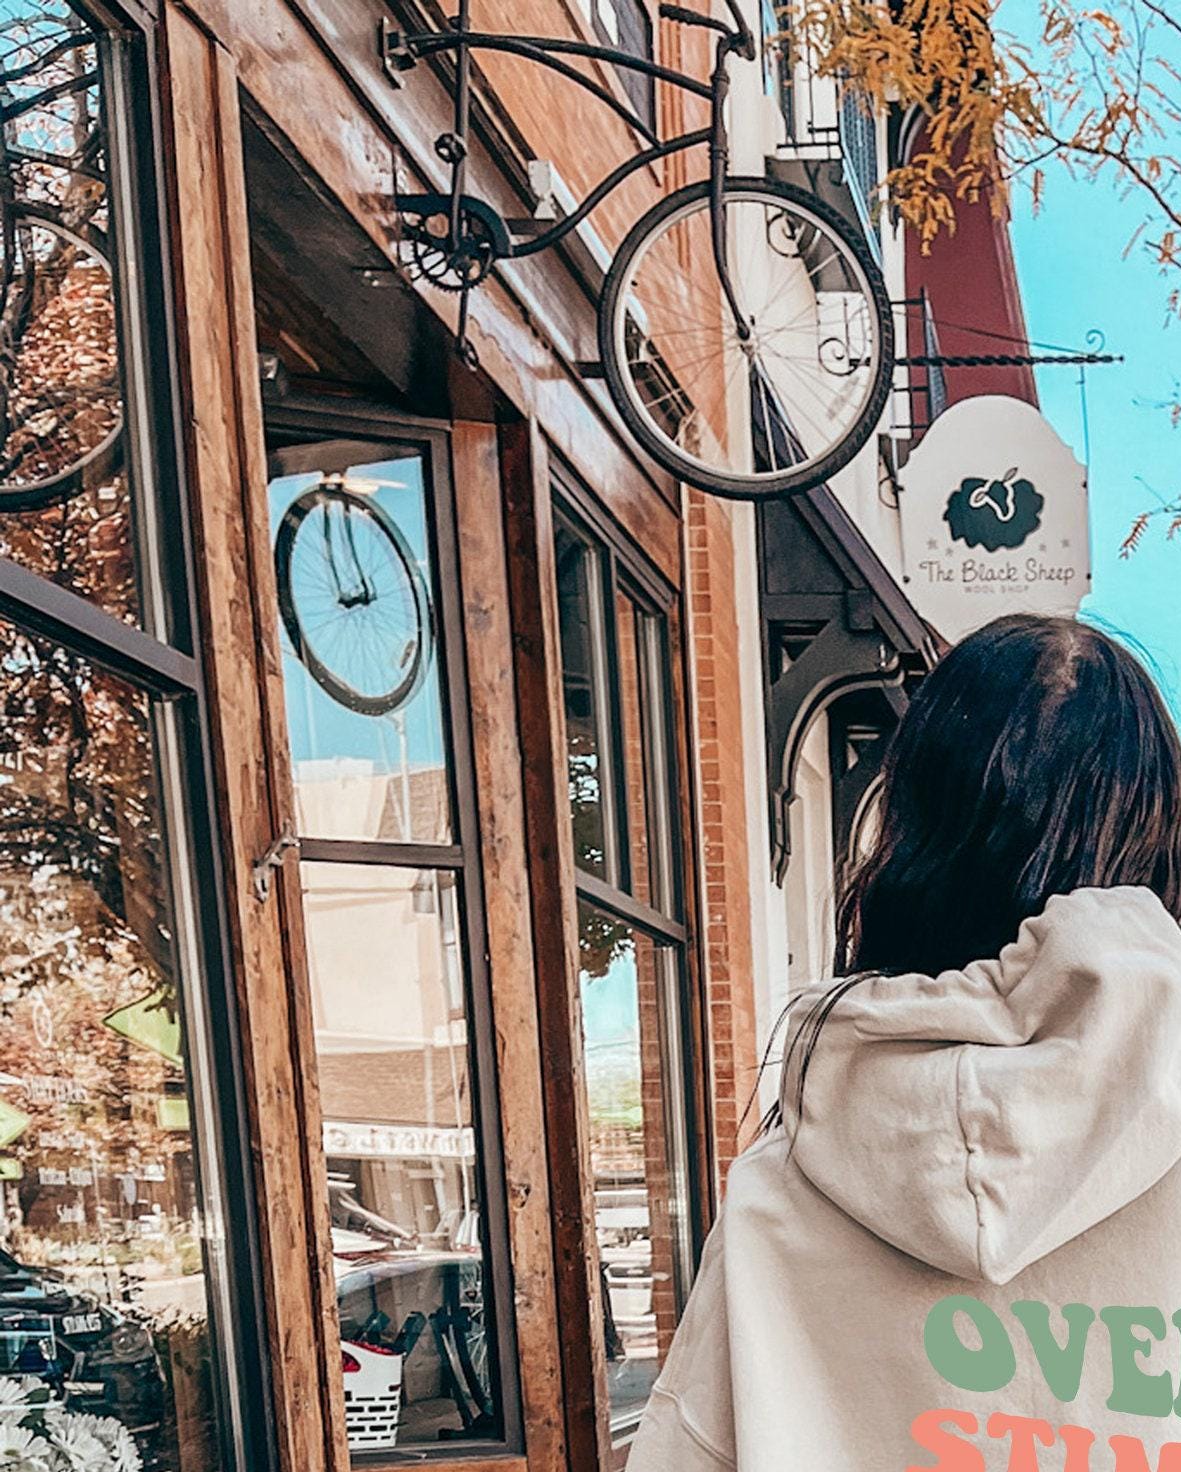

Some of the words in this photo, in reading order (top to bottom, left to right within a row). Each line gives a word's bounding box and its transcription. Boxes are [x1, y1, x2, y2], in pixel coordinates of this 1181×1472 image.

[919, 560, 955, 582] The
[962, 559, 1019, 583] Black
[1025, 558, 1075, 585] Sheep
